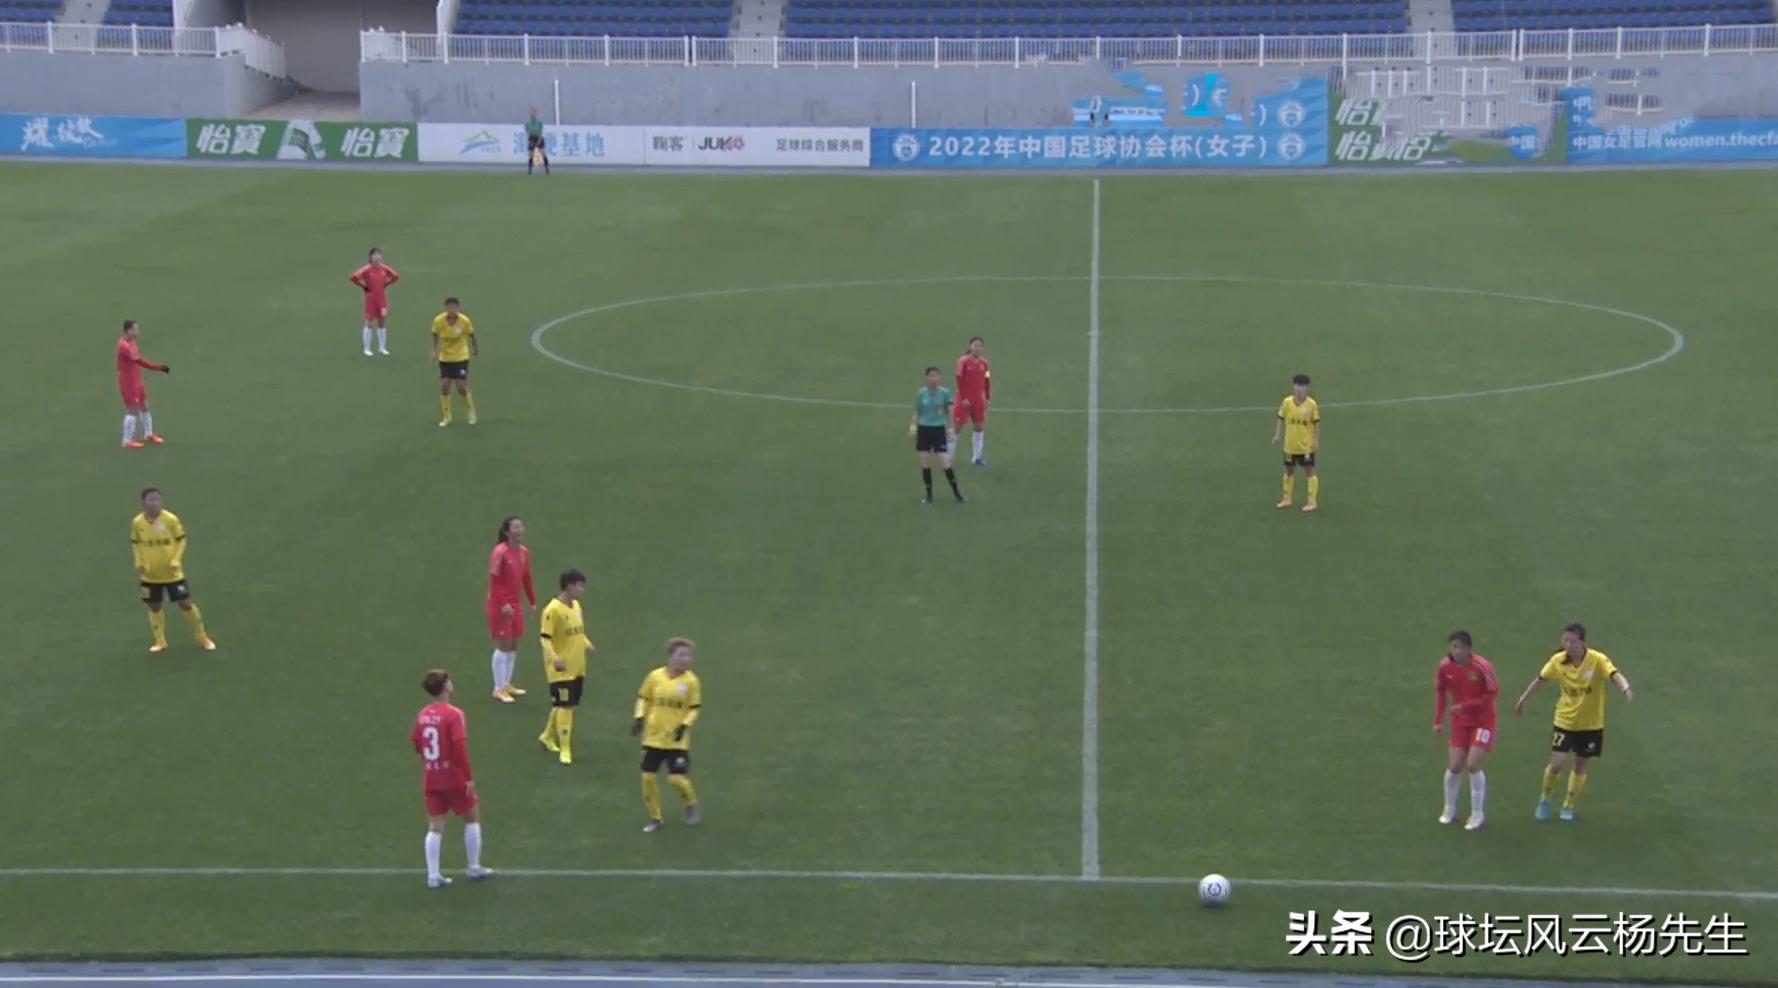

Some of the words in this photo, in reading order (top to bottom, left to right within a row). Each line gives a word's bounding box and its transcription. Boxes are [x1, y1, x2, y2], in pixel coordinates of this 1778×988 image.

[196, 124, 266, 155] 怡寶
[341, 127, 410, 158] 怡寶
[776, 138, 864, 152] 足球综合服务商
[929, 135, 1267, 159] 2022年中国足球协会杯(女子)
[422, 727, 440, 761] 3
[1476, 728, 1491, 743] 10
